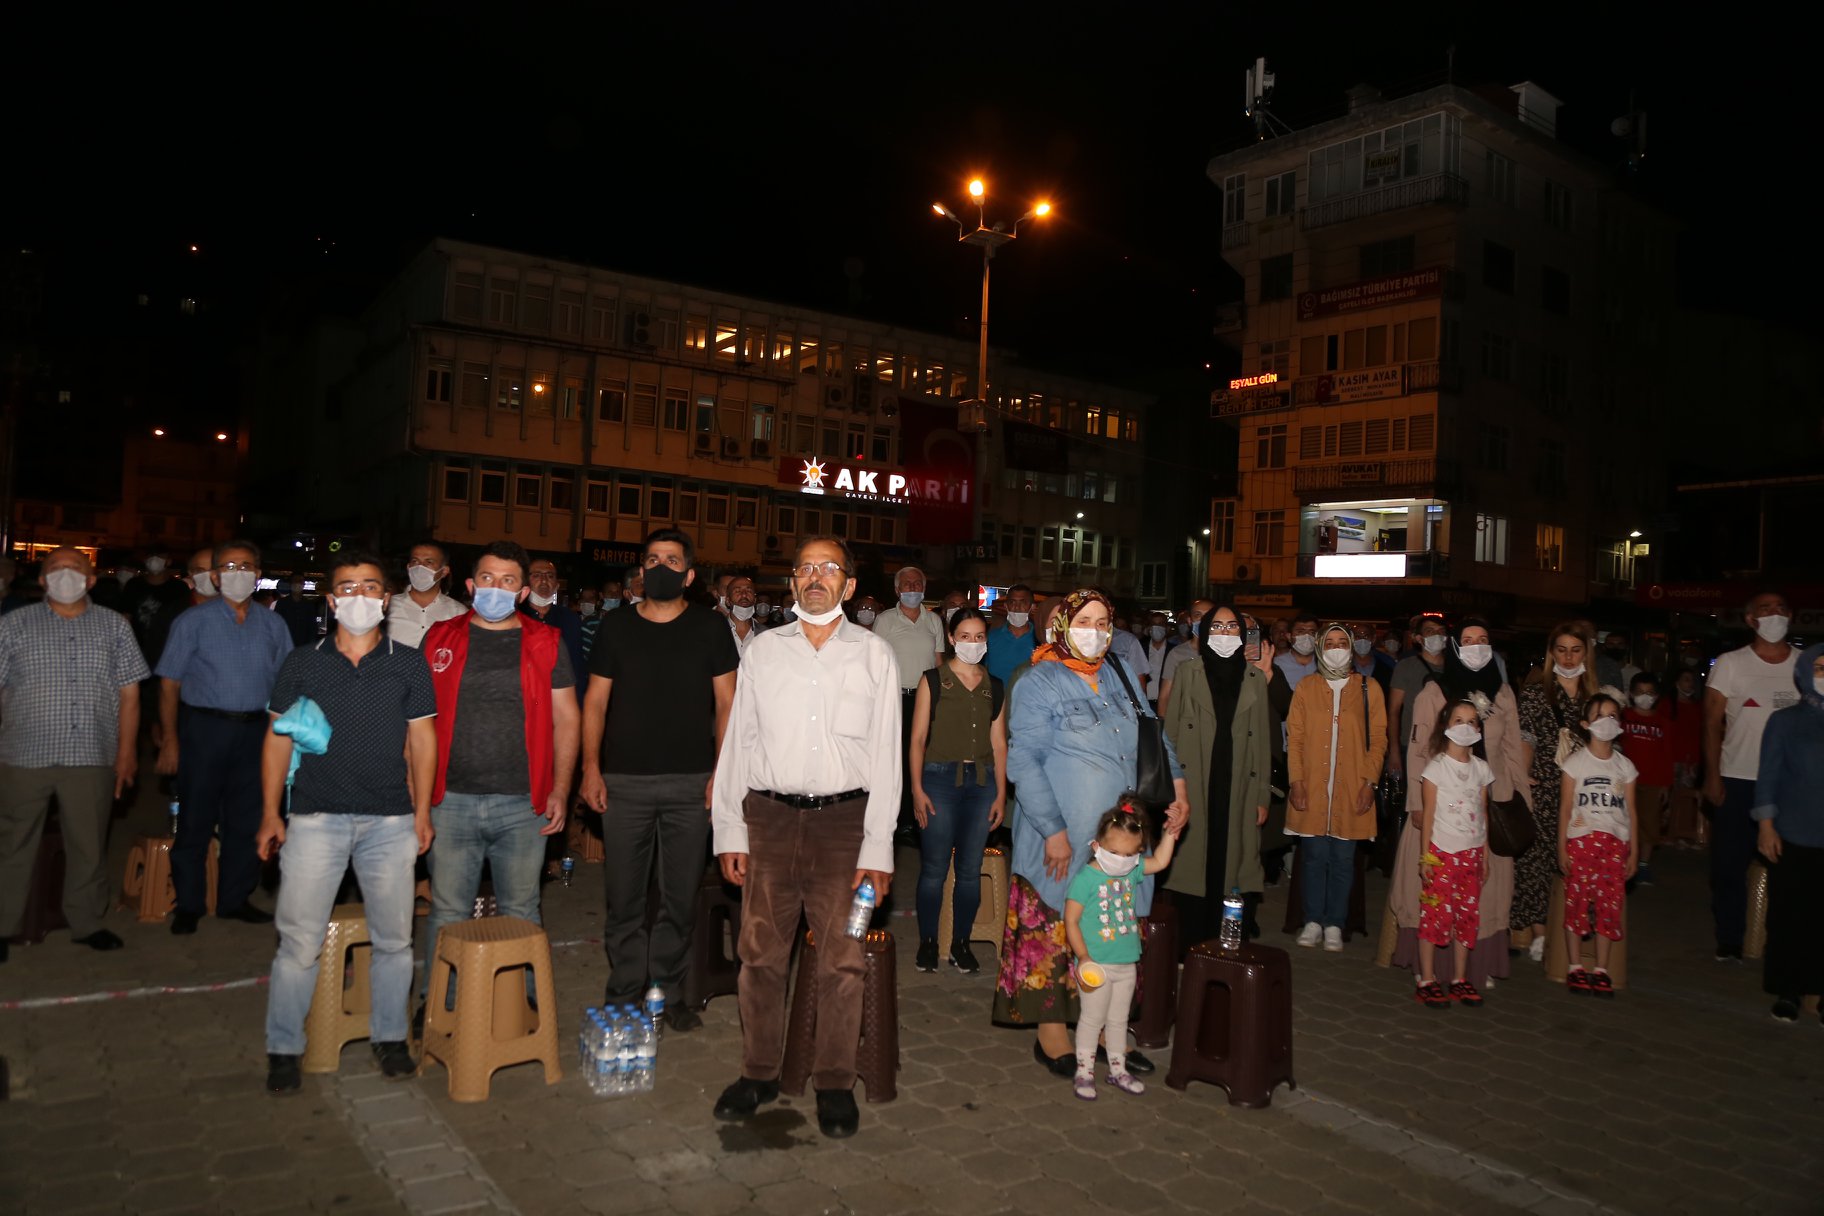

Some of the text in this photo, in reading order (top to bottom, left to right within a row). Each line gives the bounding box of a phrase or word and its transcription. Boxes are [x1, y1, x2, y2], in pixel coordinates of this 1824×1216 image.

[1362, 278, 1401, 295] TÜRKİYE
[1403, 268, 1439, 288] PARTİSİ
[1230, 373, 1277, 389] EŞYALI GÜN
[1373, 369, 1398, 382] AYAR
[1341, 463, 1379, 473] AVUKAT
[834, 468, 879, 494] AK
[593, 547, 636, 564] SARIYER
